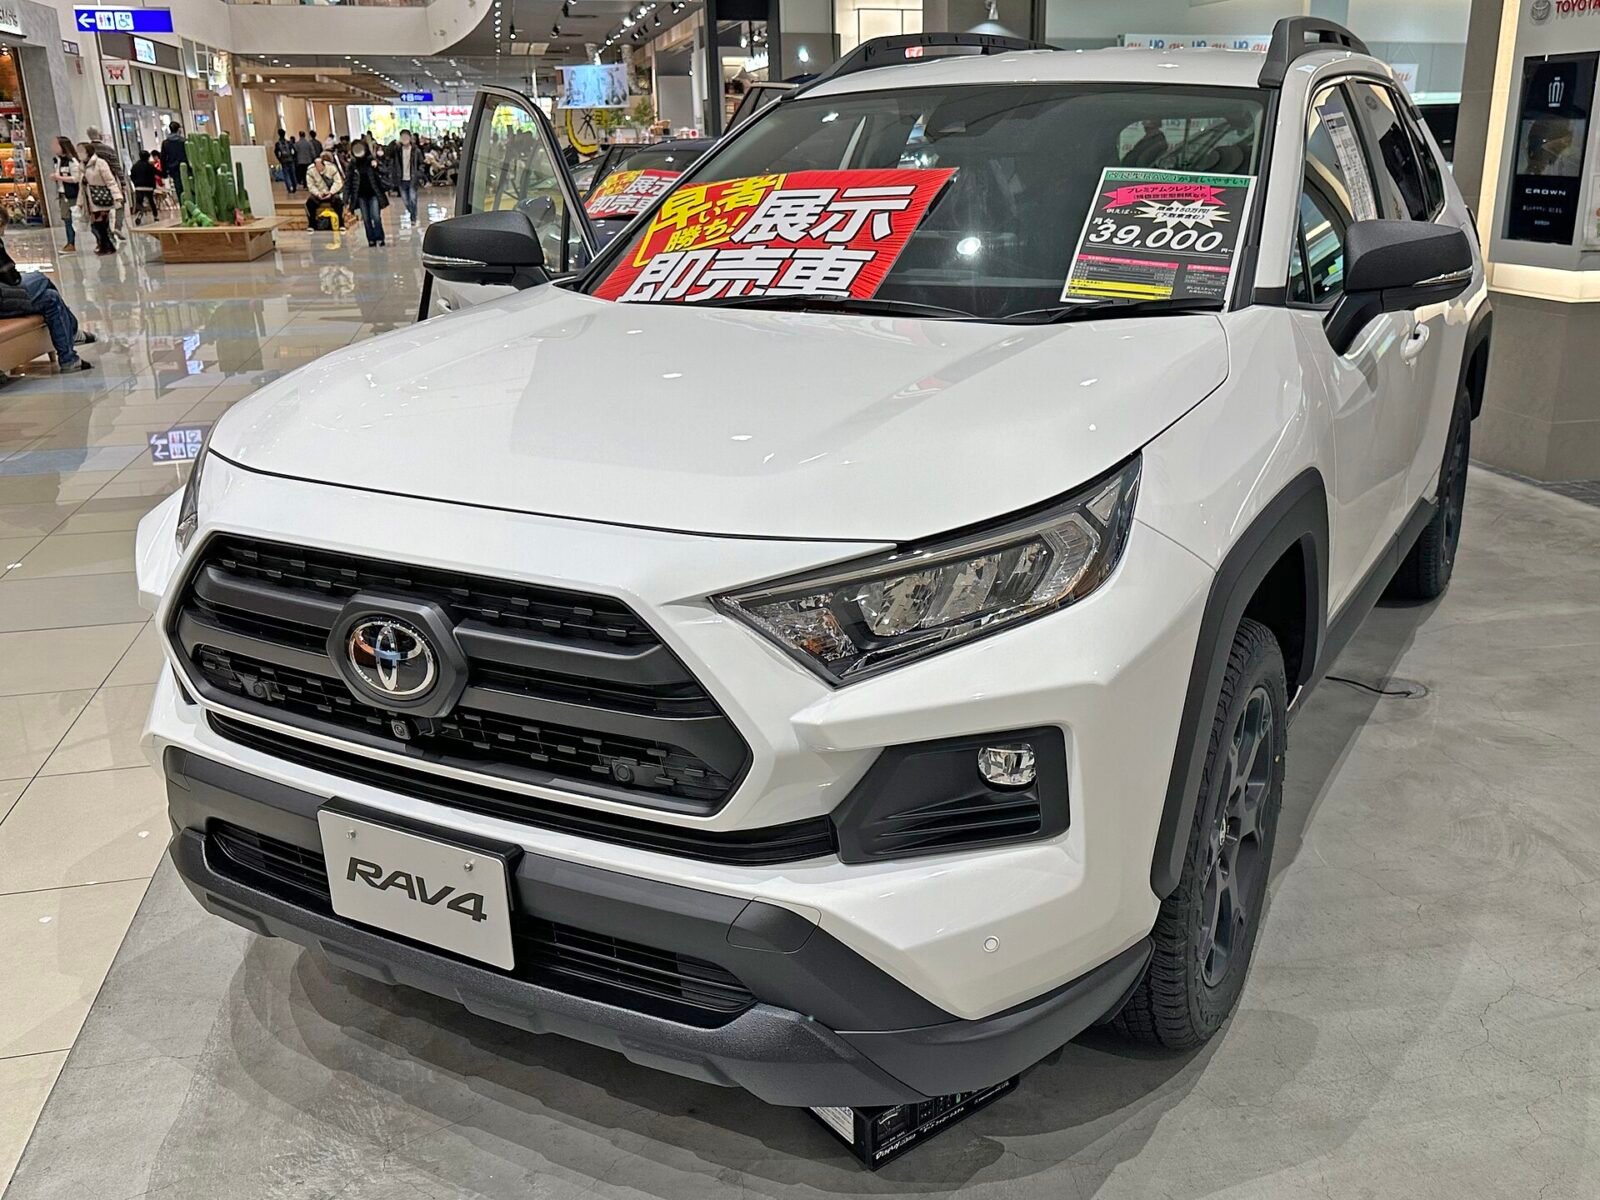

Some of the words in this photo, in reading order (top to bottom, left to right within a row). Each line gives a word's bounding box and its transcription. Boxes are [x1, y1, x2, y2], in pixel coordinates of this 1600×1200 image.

[1556, 0, 1600, 14] TOYOTA
[660, 175, 780, 230] 早い者
[1127, 185, 1206, 194] プレミアムクレジット
[1525, 187, 1567, 196] CROWN
[730, 185, 916, 244] 展示
[1088, 223, 1223, 253] 39,000
[617, 245, 876, 302] 即売車
[346, 856, 487, 922] RAV4
